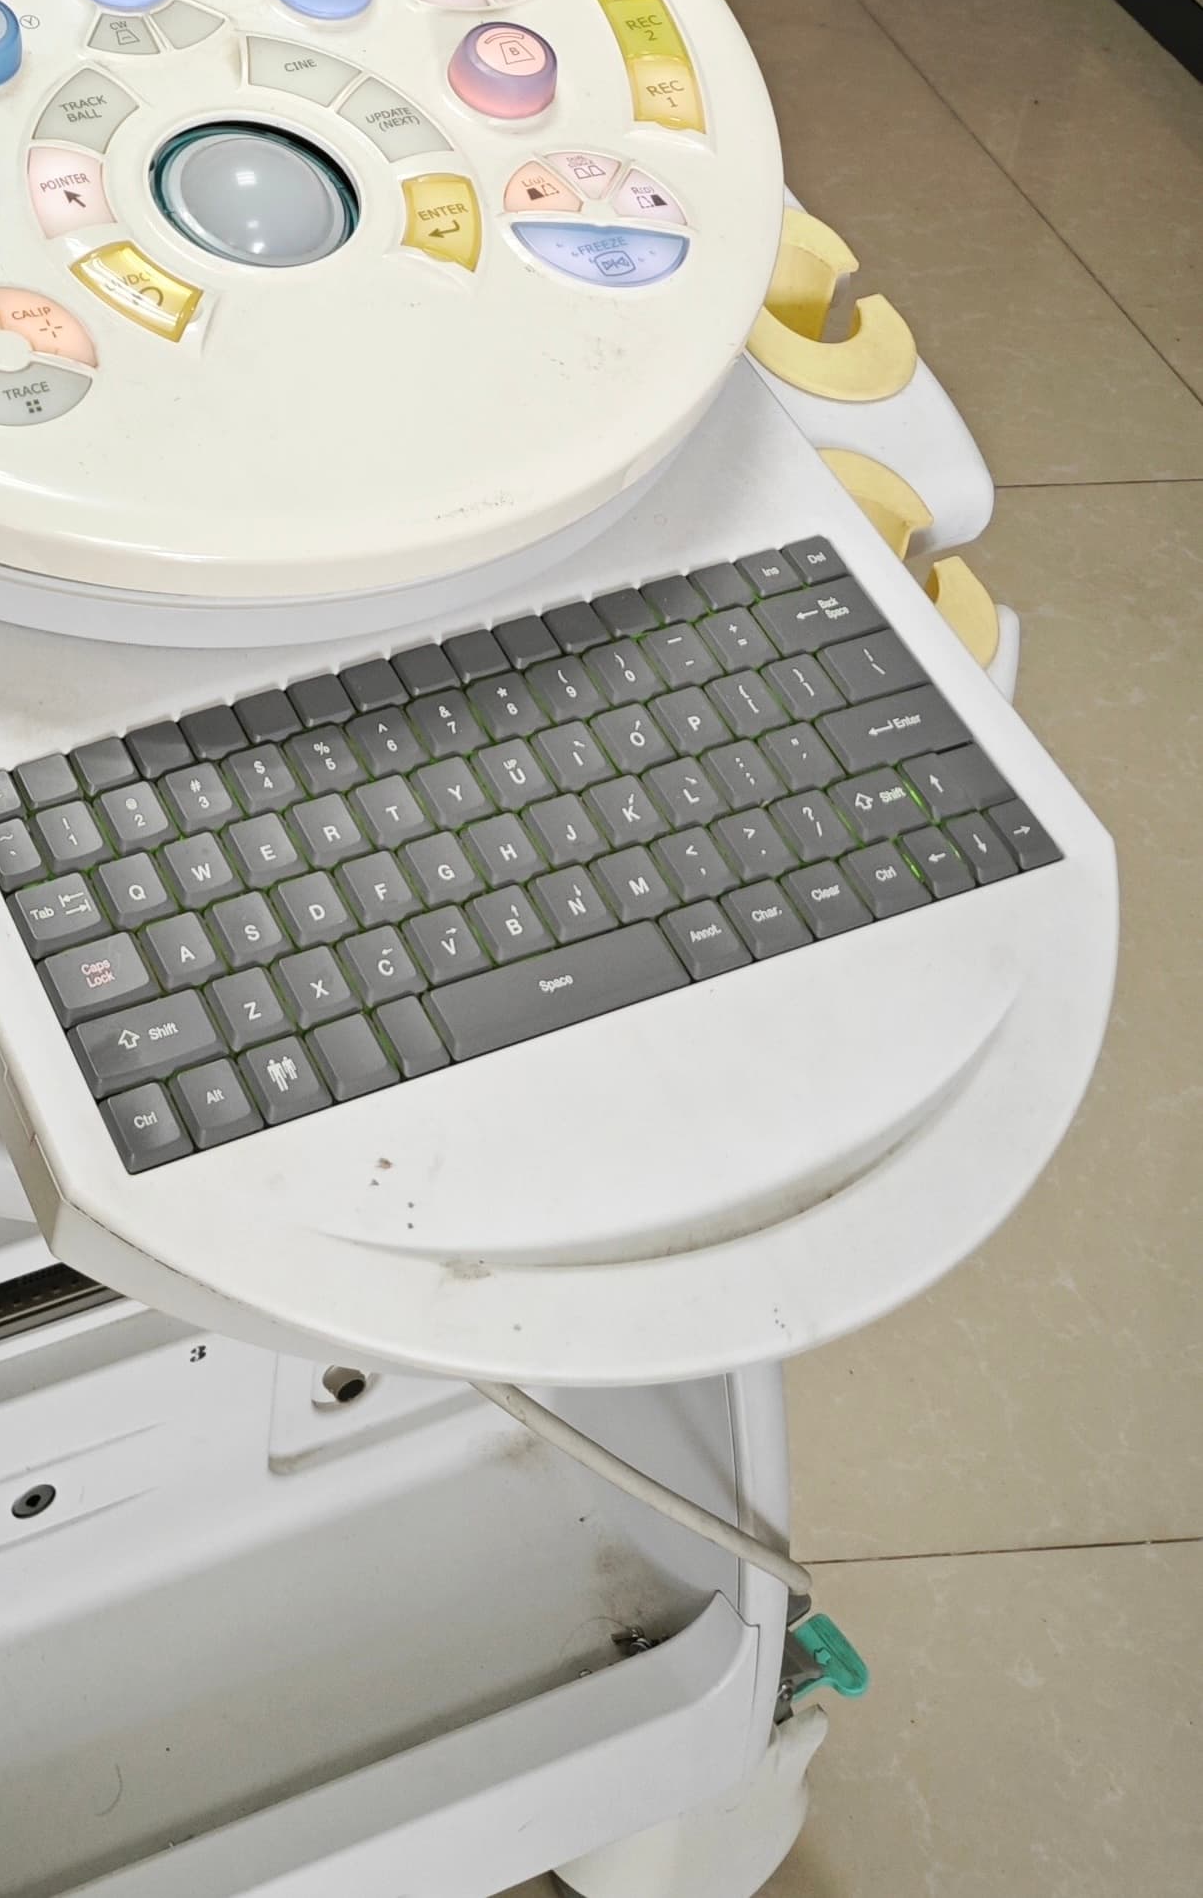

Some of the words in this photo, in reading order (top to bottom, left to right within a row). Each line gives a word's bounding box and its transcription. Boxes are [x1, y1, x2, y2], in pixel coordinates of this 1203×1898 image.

[109, 20, 127, 31] CW
[624, 13, 663, 31] REC
[643, 29, 658, 42] 2
[283, 58, 318, 74] CINE
[645, 79, 685, 97] REC
[60, 94, 108, 114] TRACK
[666, 95, 679, 108] 1
[66, 108, 103, 124] BALL
[365, 106, 412, 126] UPDATE
[377, 115, 421, 133] (NEXT)
[39, 172, 91, 194] POINTER
[417, 201, 469, 223] ENTER
[576, 235, 629, 255] FREEZE
[11, 304, 52, 322] CALIP
[1, 381, 51, 402] TRACE
[806, 553, 827, 566] Del
[761, 566, 780, 577] Ins
[565, 685, 577, 699] 9
[446, 721, 458, 734] 7
[687, 716, 701, 731] P
[892, 714, 922, 730] Enter
[386, 739, 398, 752] 6
[325, 758, 337, 771] 5
[262, 776, 274, 789] 4
[509, 768, 526, 785] U
[447, 785, 463, 801] Y
[683, 788, 699, 803] L
[878, 786, 906, 804] Shift
[198, 796, 210, 808] 3
[133, 814, 146, 827] 2
[385, 805, 400, 822] T
[622, 806, 641, 823] K
[322, 825, 341, 843] R
[565, 825, 577, 841] J
[260, 844, 276, 861] E
[499, 844, 518, 862] H
[191, 863, 211, 882] W
[437, 865, 456, 881] G
[875, 866, 897, 882] Ctrl
[128, 884, 146, 901] Q
[373, 883, 389, 901] F
[629, 877, 651, 896] M
[810, 884, 840, 902] Clear
[29, 906, 55, 921] Tab
[308, 904, 325, 921] D
[567, 898, 587, 916] N
[244, 924, 260, 941] S
[504, 918, 523, 936] B
[689, 922, 723, 943] Annot.
[180, 946, 196, 963] A
[440, 938, 457, 955] V
[81, 959, 111, 976] Caps
[377, 959, 394, 976] C
[86, 972, 115, 988] Lock
[539, 972, 575, 993] Space
[309, 980, 330, 999] X
[243, 1002, 262, 1021] Z
[148, 1022, 179, 1041] Shift
[206, 1089, 225, 1104] Alt
[133, 1111, 158, 1130] Ctrl
